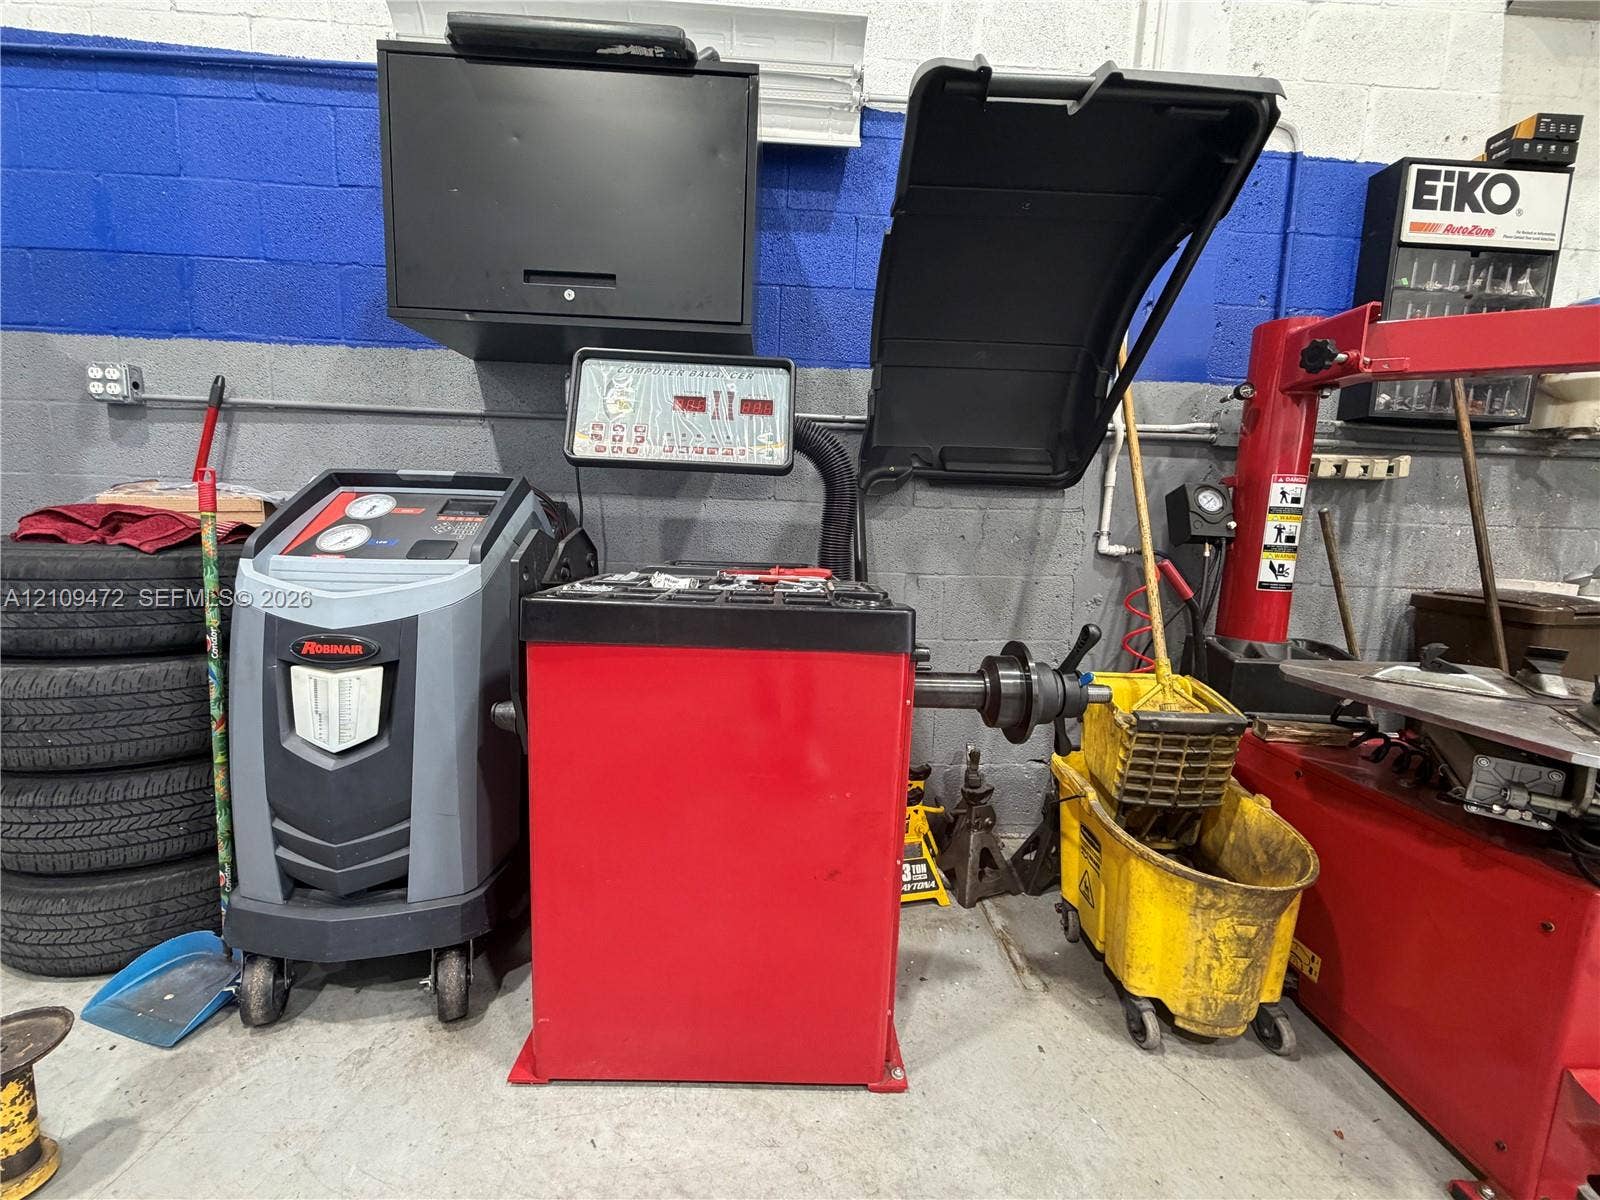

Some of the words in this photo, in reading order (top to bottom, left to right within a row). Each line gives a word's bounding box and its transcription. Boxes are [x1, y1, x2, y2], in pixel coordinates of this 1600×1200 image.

[1443, 223, 1496, 238] AutoZone
[616, 365, 684, 377] COMPUTER
[211, 626, 219, 659] Condor
[301, 641, 364, 655] ROBINAIR
[902, 863, 911, 882] 3
[911, 863, 927, 875] TON
[901, 880, 936, 892] AYTONA
